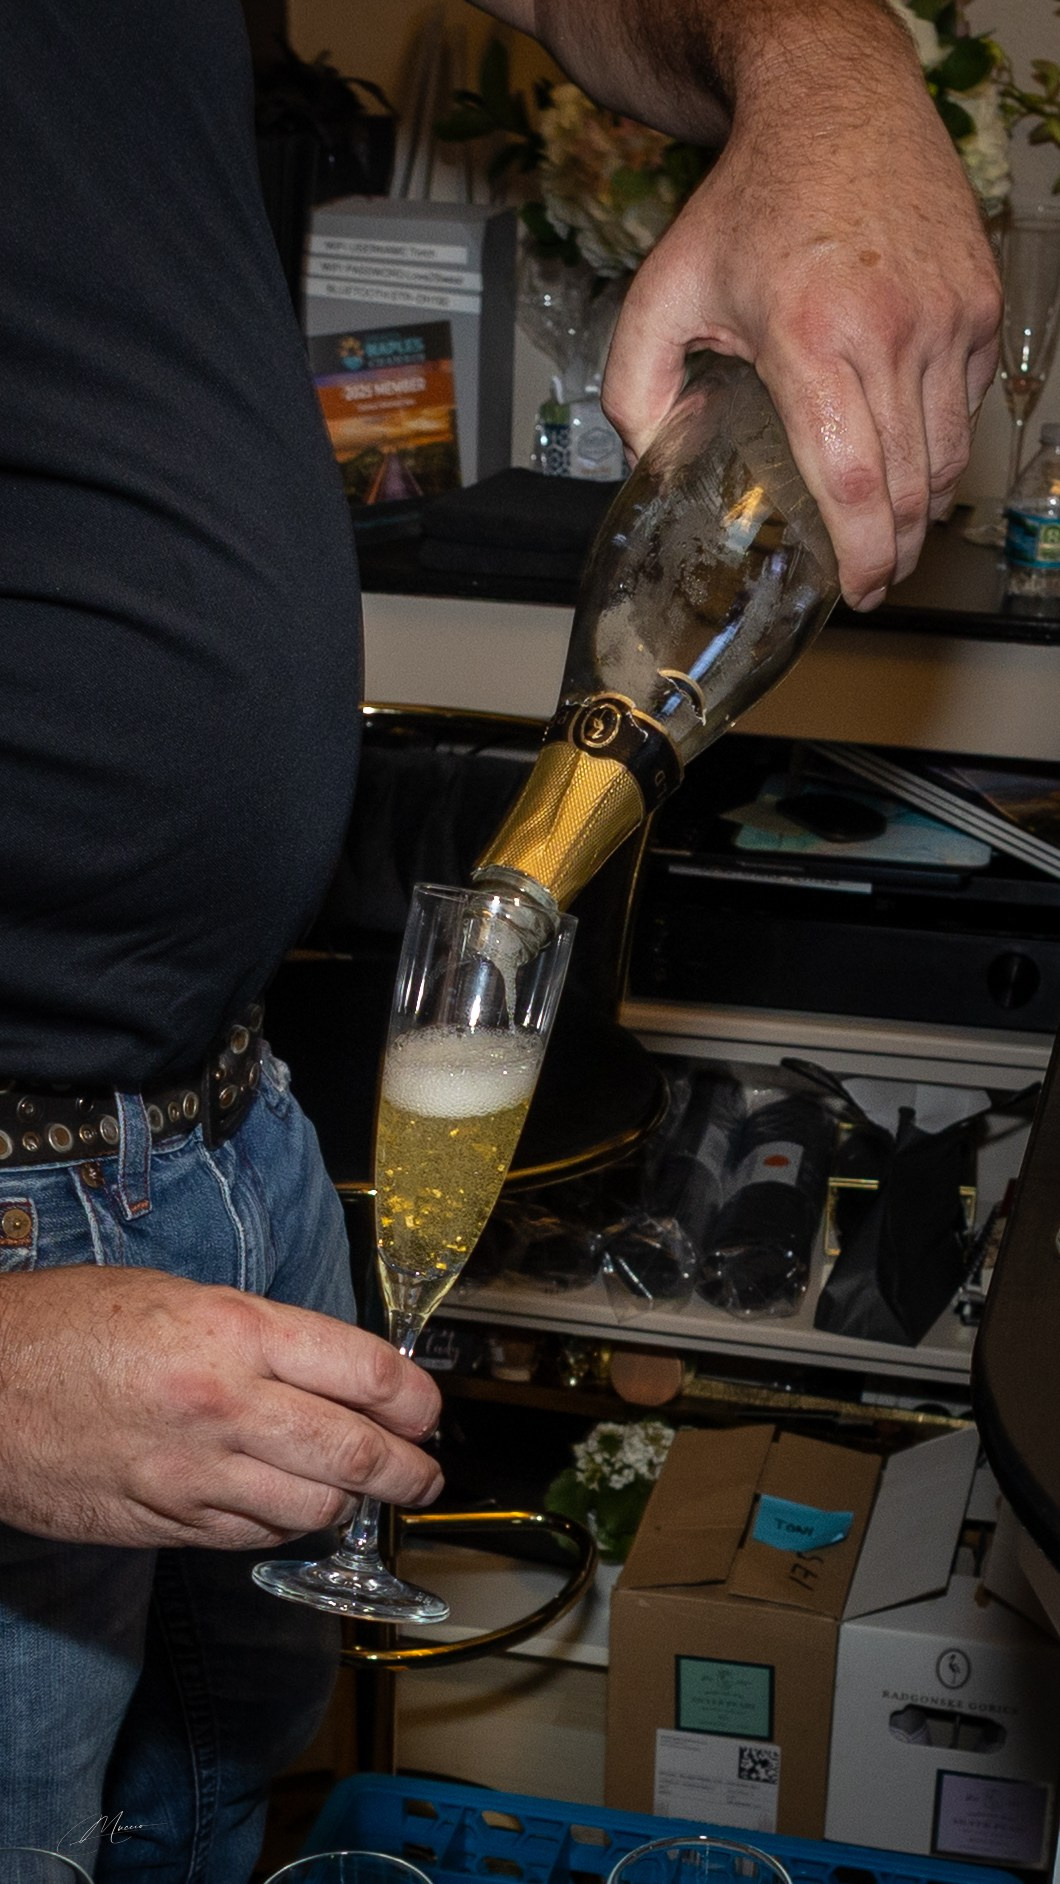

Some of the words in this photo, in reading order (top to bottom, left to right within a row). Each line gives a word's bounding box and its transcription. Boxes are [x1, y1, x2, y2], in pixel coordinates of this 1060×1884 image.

[365, 337, 424, 356] NAPLES
[374, 377, 426, 396] MEMBER
[881, 1690, 964, 1710] RADGONSKE
